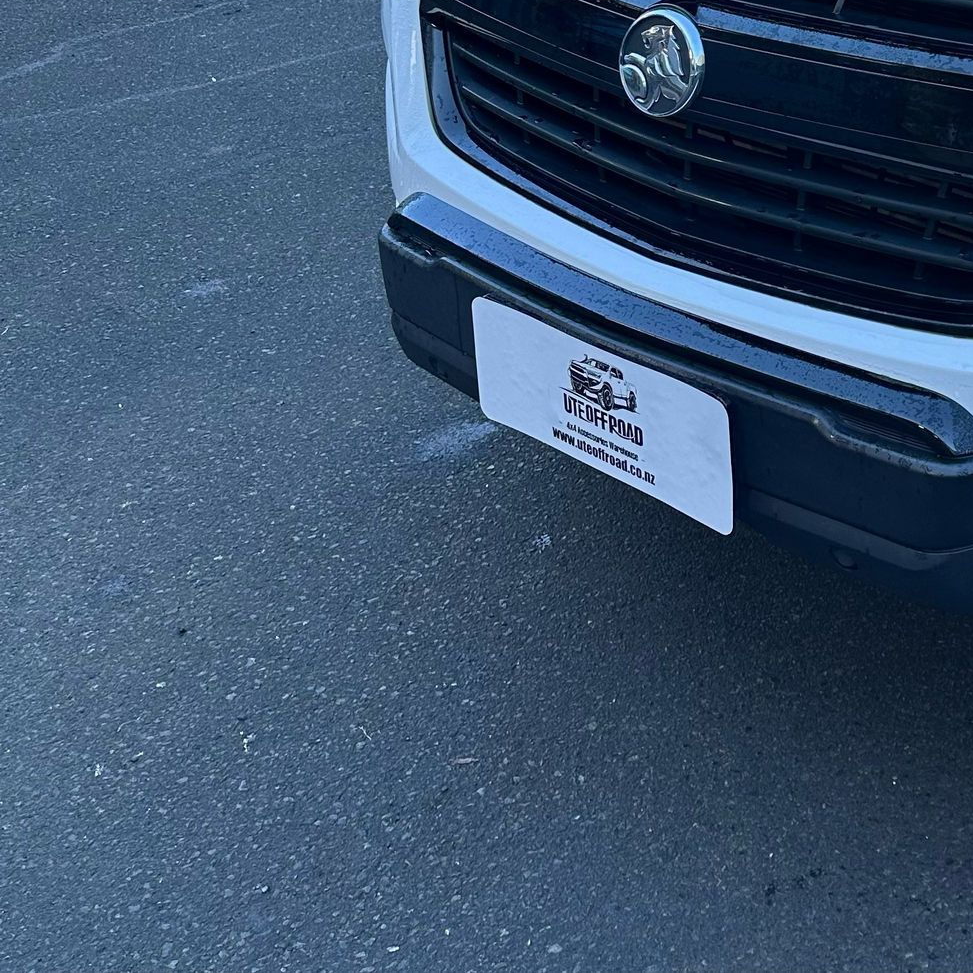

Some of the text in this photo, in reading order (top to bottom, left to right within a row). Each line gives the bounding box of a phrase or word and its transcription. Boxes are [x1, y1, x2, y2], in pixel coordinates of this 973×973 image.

[563, 392, 644, 447] UTEOFFROAD
[577, 426, 609, 448] Accessories
[608, 440, 639, 462] Warehouse
[552, 426, 656, 486] www.uteoffroad.co.nz
